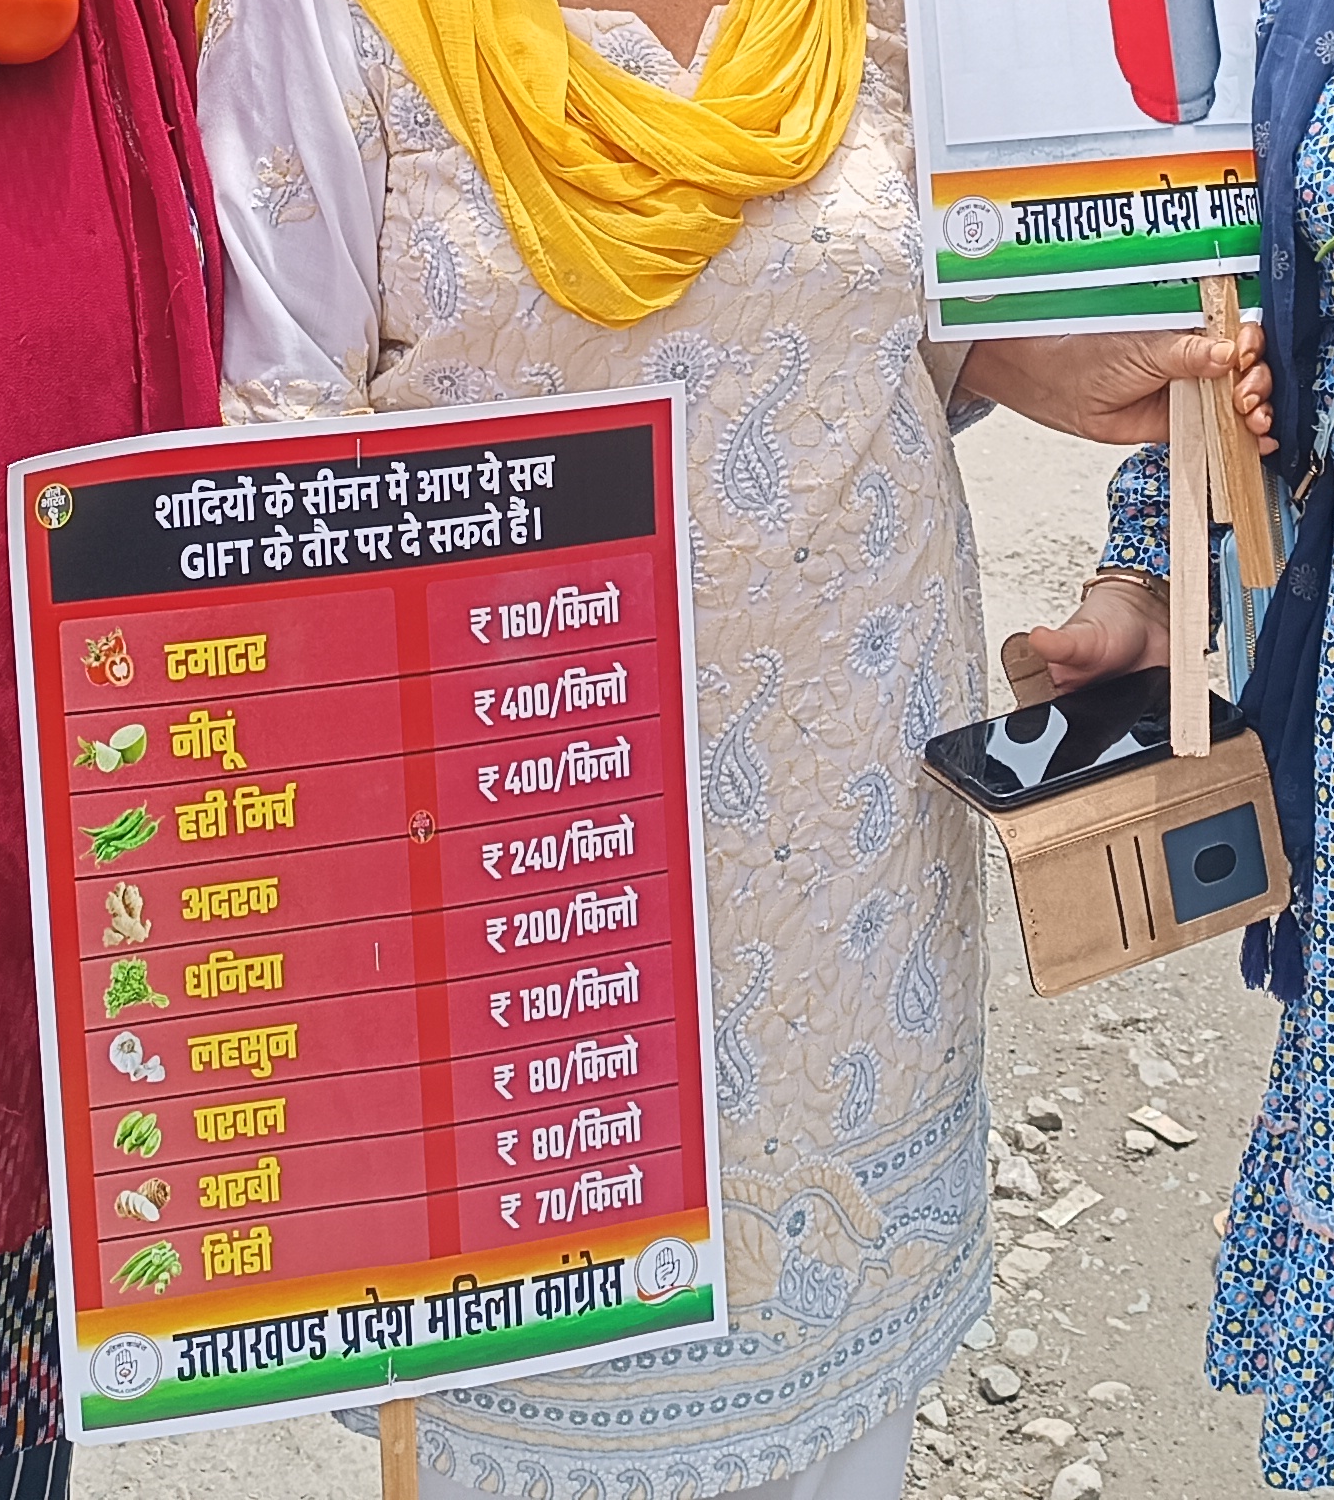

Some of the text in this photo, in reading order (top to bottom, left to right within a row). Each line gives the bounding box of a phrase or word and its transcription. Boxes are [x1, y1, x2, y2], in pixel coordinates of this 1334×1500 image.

[1011, 192, 1134, 246] उत्तराखण्ड
[1140, 173, 1200, 237] प्रदेश
[154, 451, 556, 530] शादियों के सीजन में आप ये सब
[180, 539, 253, 581] GIFT
[260, 527, 294, 572] के
[299, 518, 349, 568] तौर
[354, 523, 392, 562] पर
[397, 512, 422, 557] दे
[426, 508, 502, 555] सकते
[498, 581, 620, 639] 160/किलो
[164, 634, 267, 681] टमाटर
[500, 661, 627, 721] 400/किलो
[504, 736, 631, 795] 400/किलो
[175, 782, 297, 842] हरी मिर्च
[510, 813, 635, 875] 240/किलो
[181, 877, 279, 922] अदरक
[514, 885, 638, 947] 200/किलो
[185, 950, 284, 998] धनिया
[519, 961, 640, 1022] 130/किलो
[187, 1023, 298, 1078] लहसुन
[528, 1034, 639, 1094] 80/किलो
[193, 1098, 286, 1143] परवल
[532, 1101, 642, 1161] 80/किलो
[199, 1156, 281, 1209] अरबी
[535, 1163, 643, 1224] 70/किलो
[201, 1225, 272, 1281] भिंडी
[172, 1250, 625, 1382] उत्तराखण्ड प्रदेश महिला कांग्रेस
